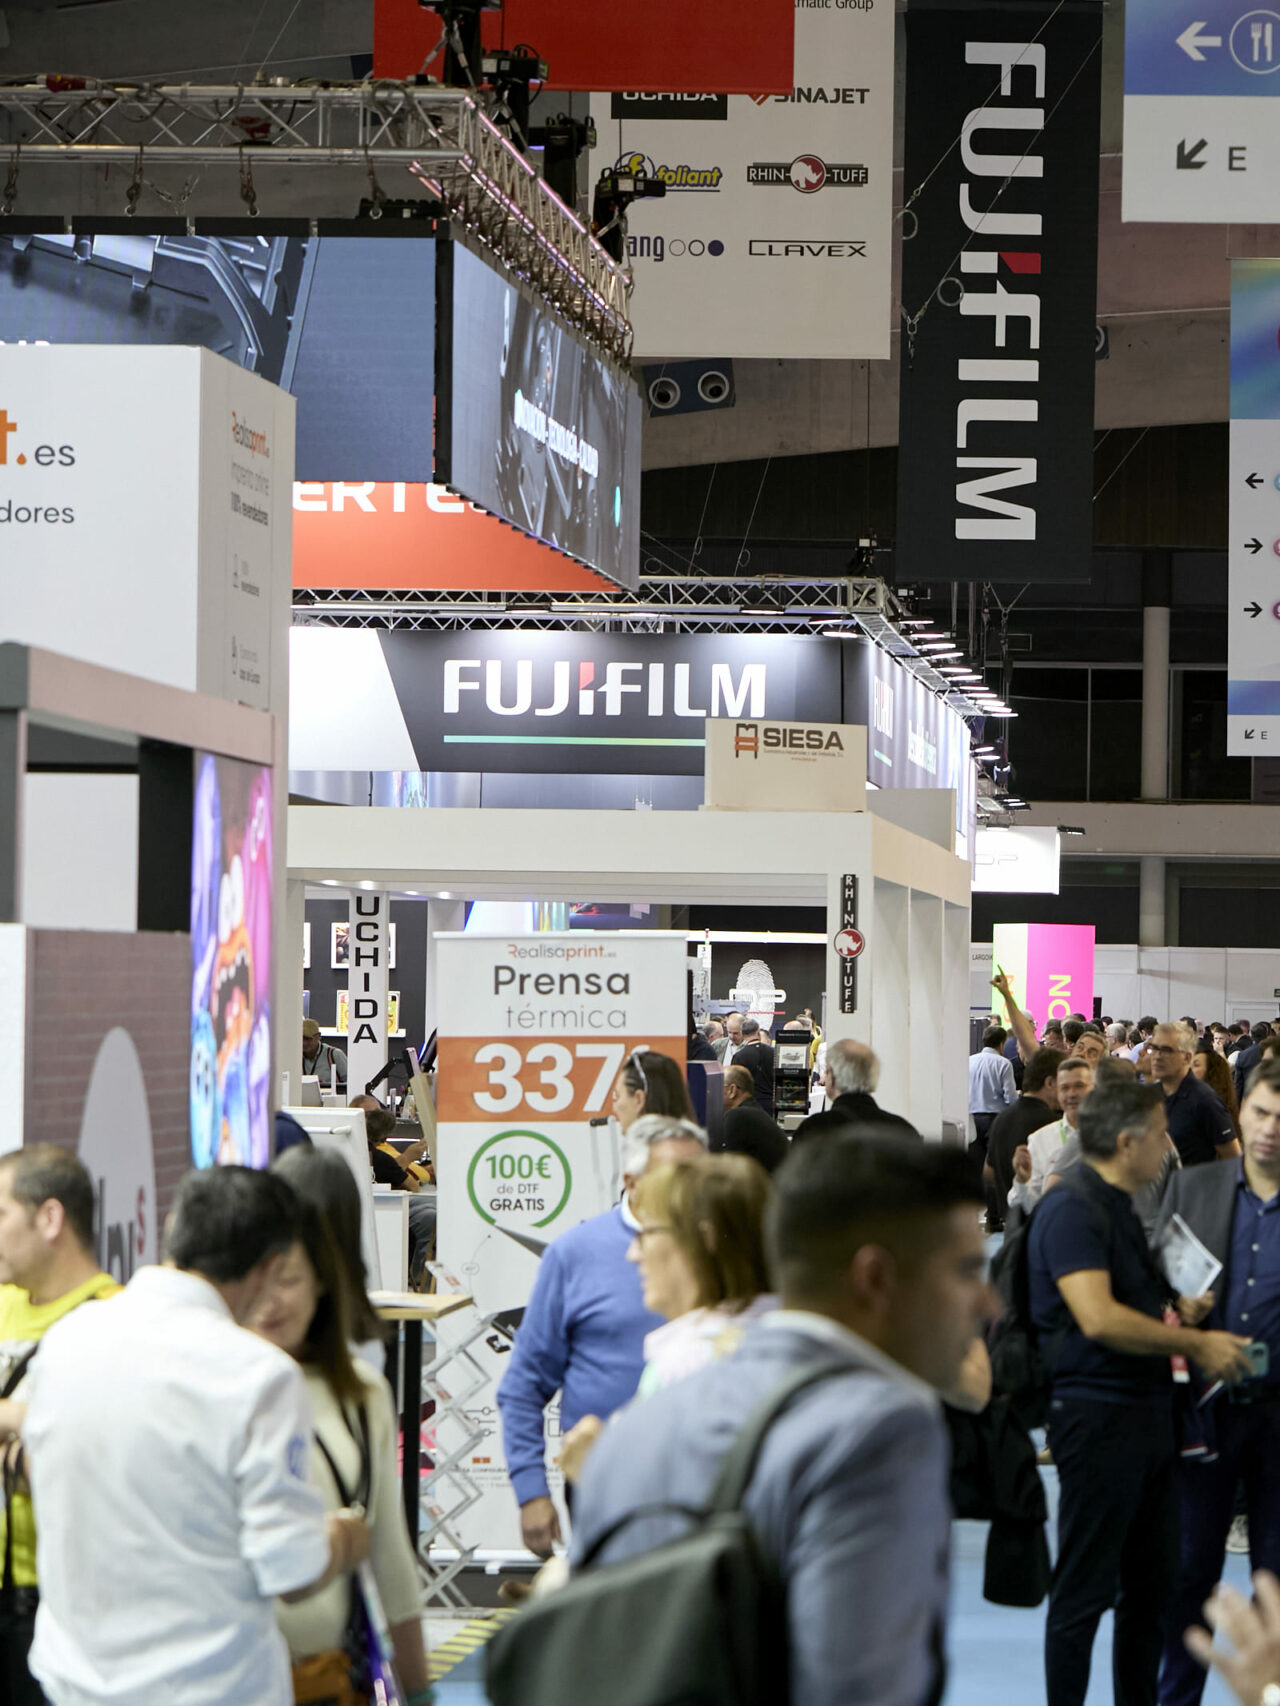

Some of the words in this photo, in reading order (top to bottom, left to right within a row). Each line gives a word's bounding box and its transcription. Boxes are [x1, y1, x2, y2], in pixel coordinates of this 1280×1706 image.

[1228, 146, 1247, 172] E
[656, 165, 724, 188] foliant
[749, 240, 868, 257] CLAVEX
[955, 42, 1046, 541] FUJIFILM
[443, 659, 766, 718] FUJIFILM
[763, 727, 845, 751] SIESA
[353, 896, 380, 1044] UCHIDA
[494, 965, 630, 995] Prensa
[506, 1003, 627, 1029] térmica
[485, 1154, 552, 1179] 100€
[497, 1183, 514, 1194] de
[518, 1183, 539, 1194] DTF
[490, 1198, 545, 1212] GRATIS
